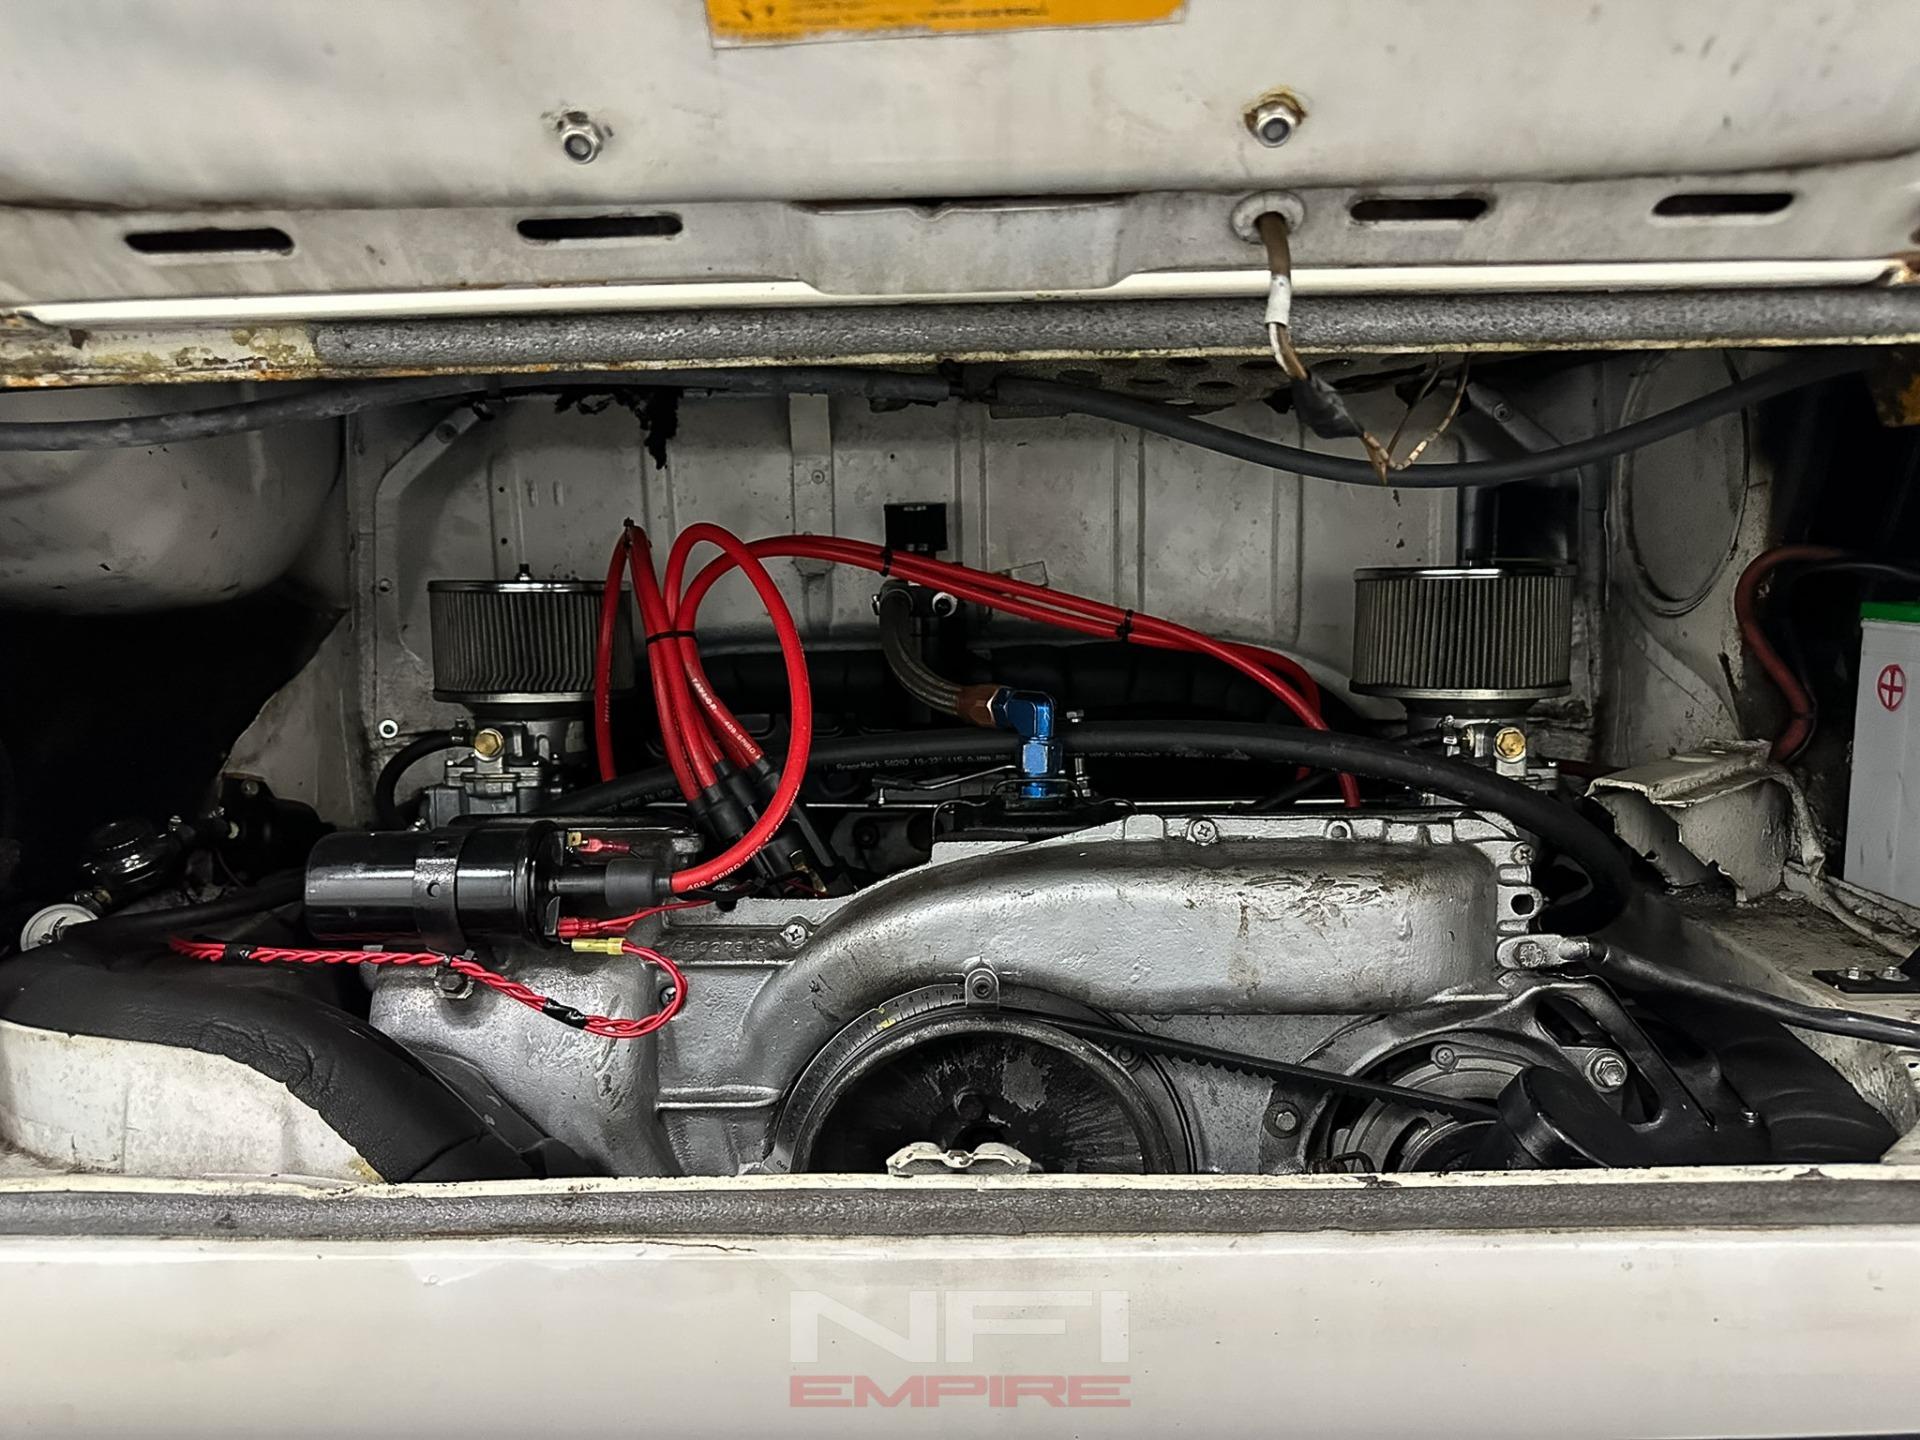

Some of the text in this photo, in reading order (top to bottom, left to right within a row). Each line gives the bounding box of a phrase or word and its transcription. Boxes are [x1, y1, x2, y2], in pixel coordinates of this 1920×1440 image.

[692, 677, 717, 710] TAYLOR
[687, 880, 708, 891] 409
[712, 862, 741, 882] SPIRO
